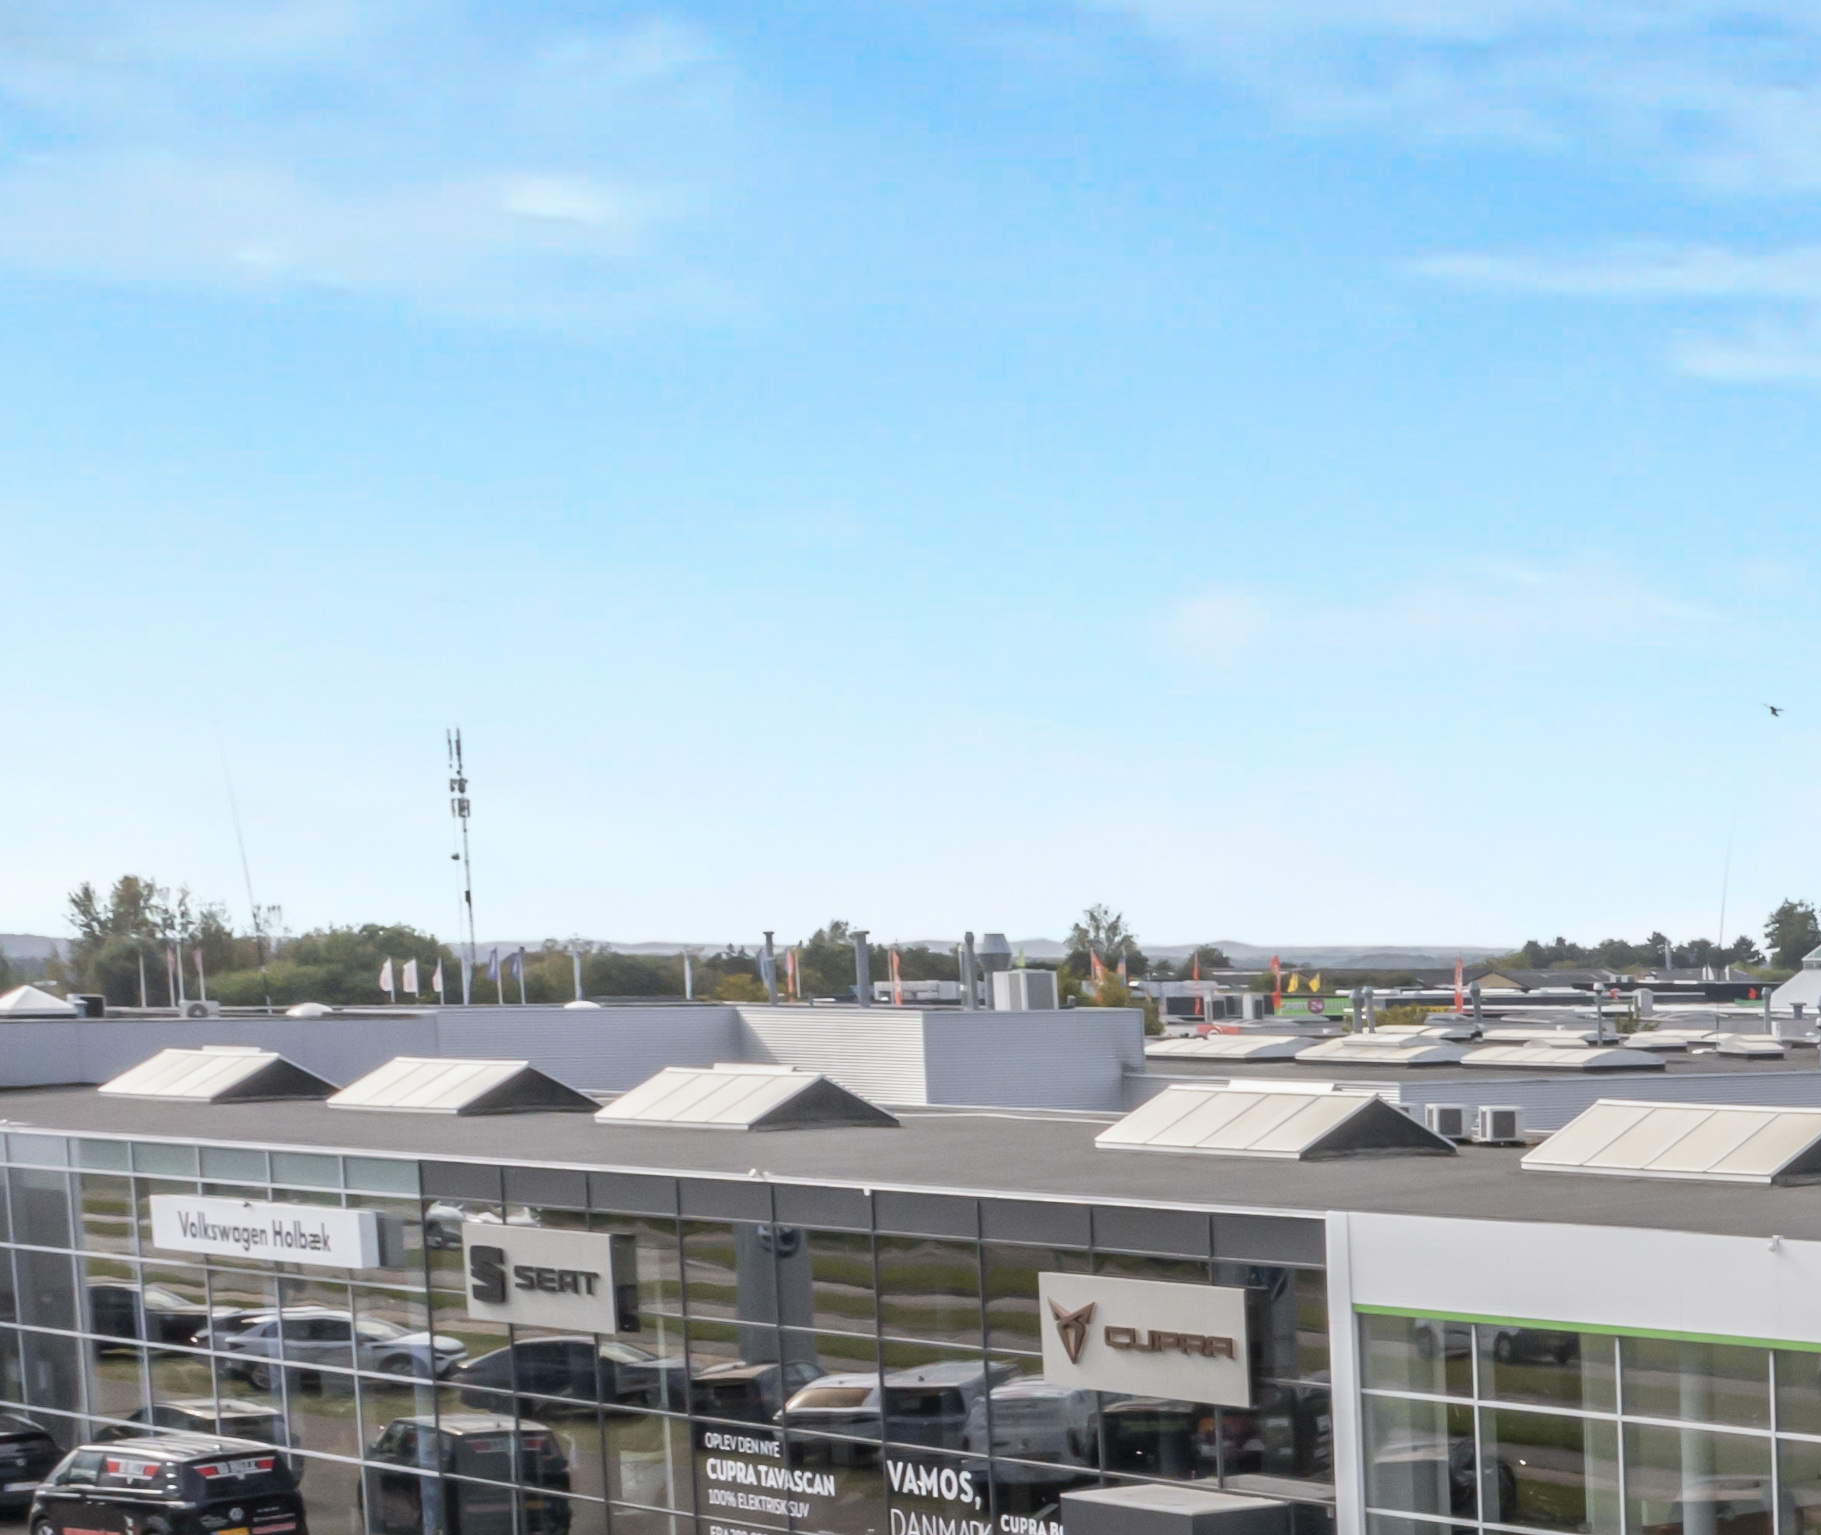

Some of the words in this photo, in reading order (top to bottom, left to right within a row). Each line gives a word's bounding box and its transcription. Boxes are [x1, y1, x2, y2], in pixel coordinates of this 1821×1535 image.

[178, 1210, 268, 1251] Volkswagen
[272, 1219, 332, 1252] Holbæk
[514, 1265, 599, 1295] SEAT
[1104, 1326, 1236, 1360] CUPRA
[705, 1432, 737, 1451] OPLEV
[738, 1437, 758, 1454] DEN
[759, 1441, 781, 1458] NYE
[706, 1457, 757, 1486] CUPRA
[757, 1464, 836, 1497] TAVASCAN
[887, 1460, 982, 1510] VAMOS,
[737, 1492, 788, 1515] ELEKTRISK
